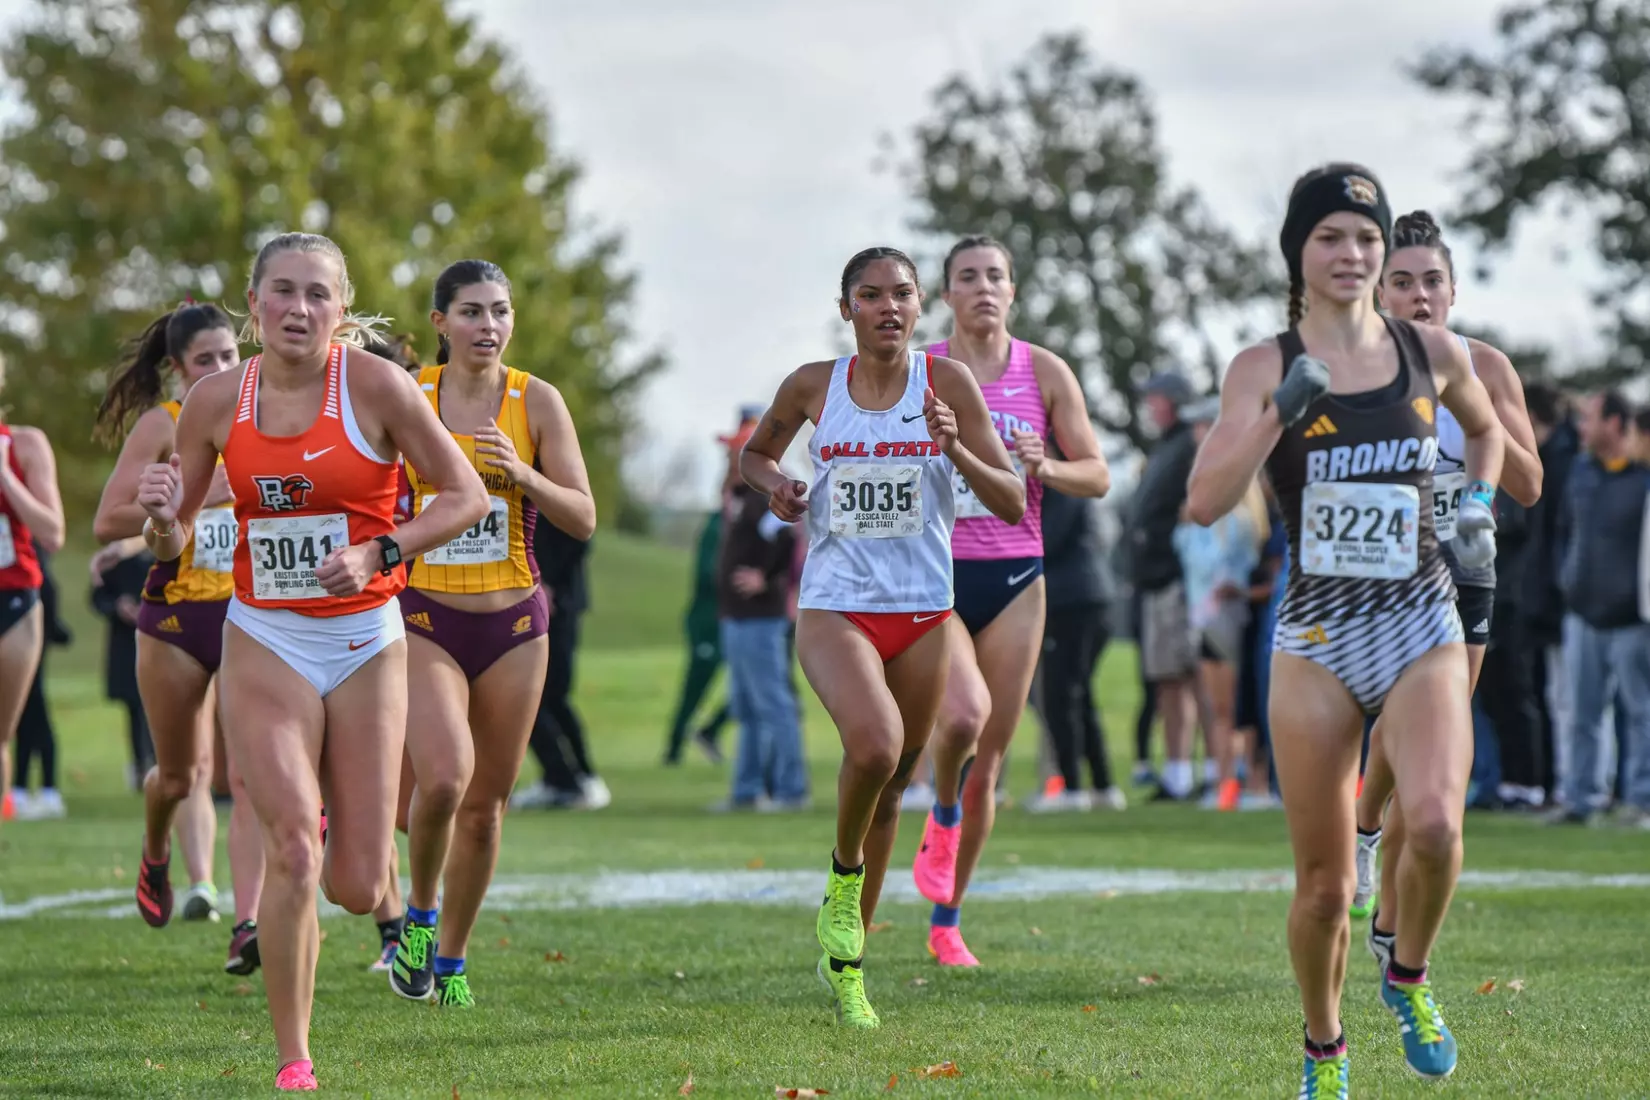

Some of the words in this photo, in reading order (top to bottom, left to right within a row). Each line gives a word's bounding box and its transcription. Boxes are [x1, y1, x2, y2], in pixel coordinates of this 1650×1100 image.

[820, 441, 869, 462] BALL
[873, 440, 941, 457] STATE
[1306, 436, 1440, 483] BRONCO
[840, 481, 912, 512] 3035
[854, 512, 880, 521] JESSICA
[881, 512, 899, 521] VELEZ
[859, 521, 874, 529] BALL
[876, 520, 894, 529] STATE
[1315, 505, 1405, 544] 3224
[259, 534, 333, 571] 3041
[274, 571, 298, 579] KRISTIN
[300, 570, 315, 579] GRO
[275, 579, 304, 589] BOWLING
[306, 579, 319, 587] GRE
